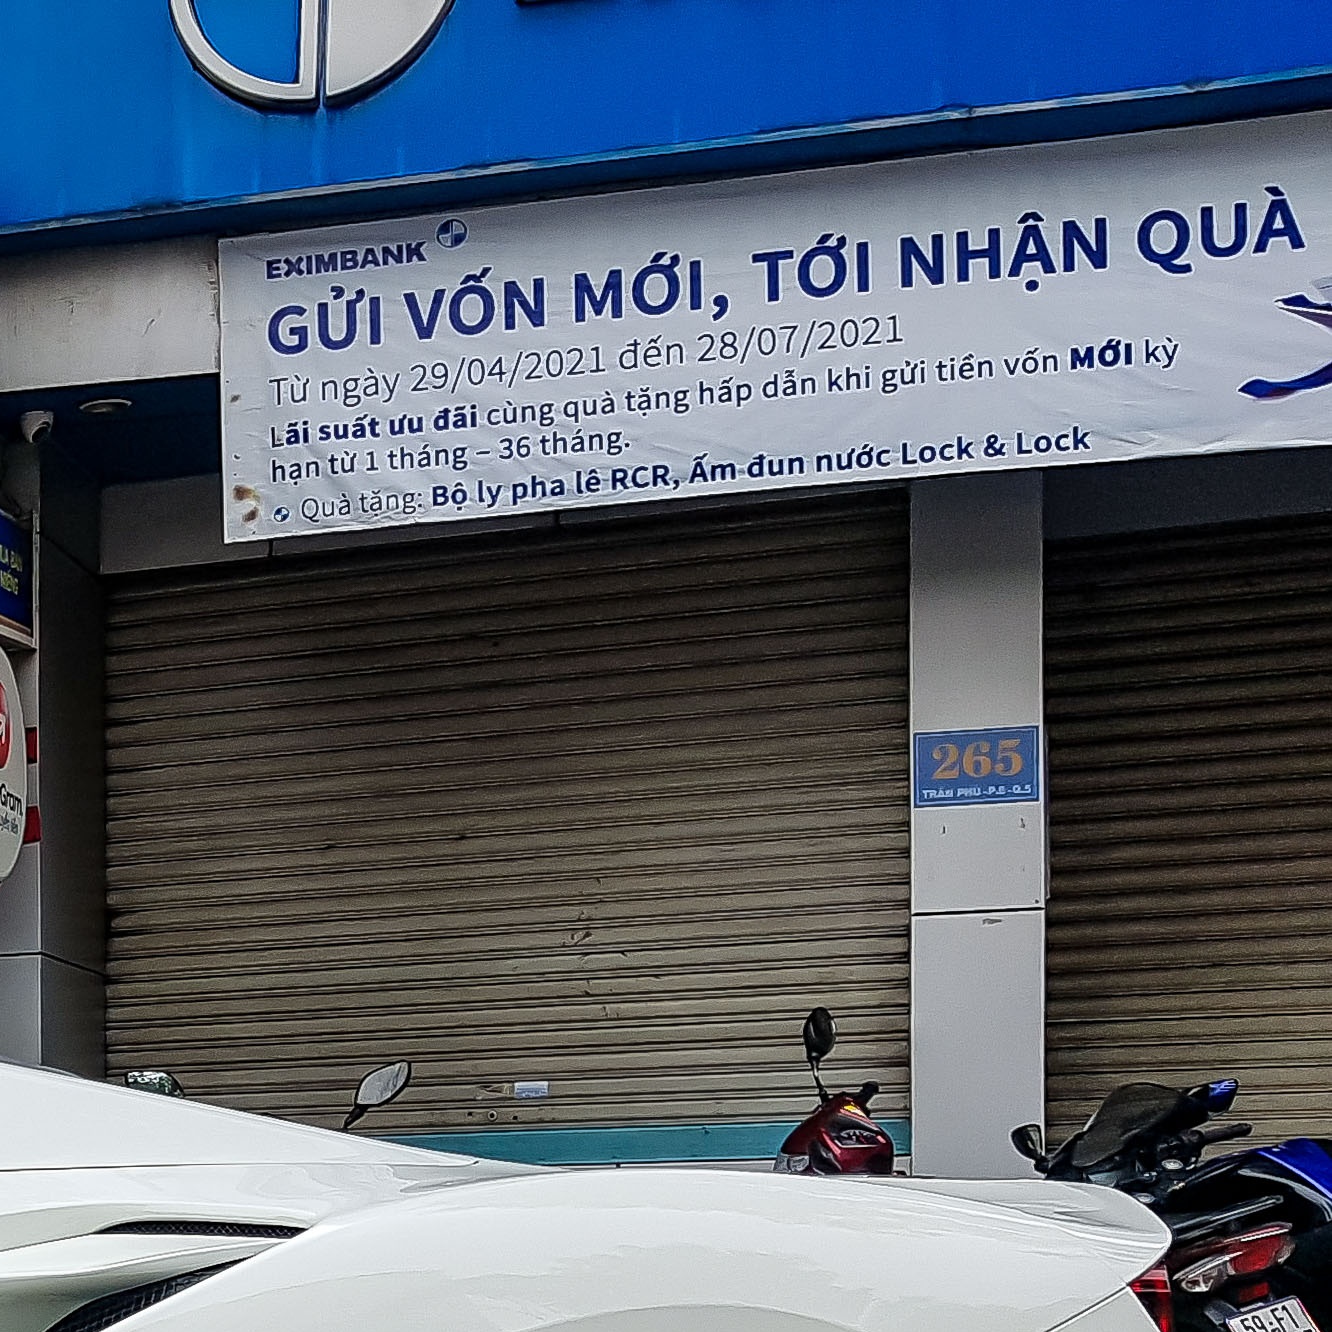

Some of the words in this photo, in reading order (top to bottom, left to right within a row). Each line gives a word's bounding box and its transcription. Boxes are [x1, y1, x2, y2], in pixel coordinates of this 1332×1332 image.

[266, 241, 427, 280] EXIMBANK
[267, 285, 381, 355] GỬI
[403, 267, 546, 340] VỐN
[574, 252, 729, 322] MỚI,
[751, 233, 870, 303] TỚI
[899, 212, 1108, 292] NHẬN
[1137, 186, 1306, 275] QUÀ
[269, 374, 310, 405] Từ
[321, 368, 401, 407] ngày
[410, 346, 606, 394] 29/04/2021
[619, 335, 684, 370] đến
[697, 315, 903, 364] 28/07/2021
[271, 421, 310, 448] Lãi
[318, 414, 381, 442] suất
[389, 414, 424, 436] ưu
[433, 404, 478, 432] đãi
[487, 401, 554, 427] cùng
[563, 391, 616, 423] quà
[625, 387, 689, 417] tặng
[699, 376, 752, 407] hấp
[762, 369, 817, 398] dẫn
[827, 365, 871, 393] khi
[881, 360, 926, 394] gửi
[935, 353, 994, 382] tiền
[1004, 348, 1058, 376] vốn
[1070, 338, 1133, 370] MỚI
[1145, 337, 1180, 369] kỳ
[272, 460, 321, 485] hạn
[328, 450, 357, 475] từ
[366, 451, 379, 471] 1
[388, 444, 468, 470] tháng
[498, 436, 531, 460] 36
[540, 429, 630, 456] tháng.
[301, 493, 352, 522] Quà
[360, 490, 423, 516] tặng:
[432, 482, 468, 511] Bộ
[478, 480, 502, 508] ly
[512, 475, 565, 506] pha
[576, 469, 601, 495] lê
[611, 464, 680, 491] RCR,
[689, 453, 736, 484] Ấm
[747, 453, 805, 478] đun
[816, 444, 891, 472] nước
[901, 435, 974, 465] Lock
[984, 434, 1006, 457] &
[1016, 426, 1091, 455] Lock
[932, 739, 1023, 779] 265
